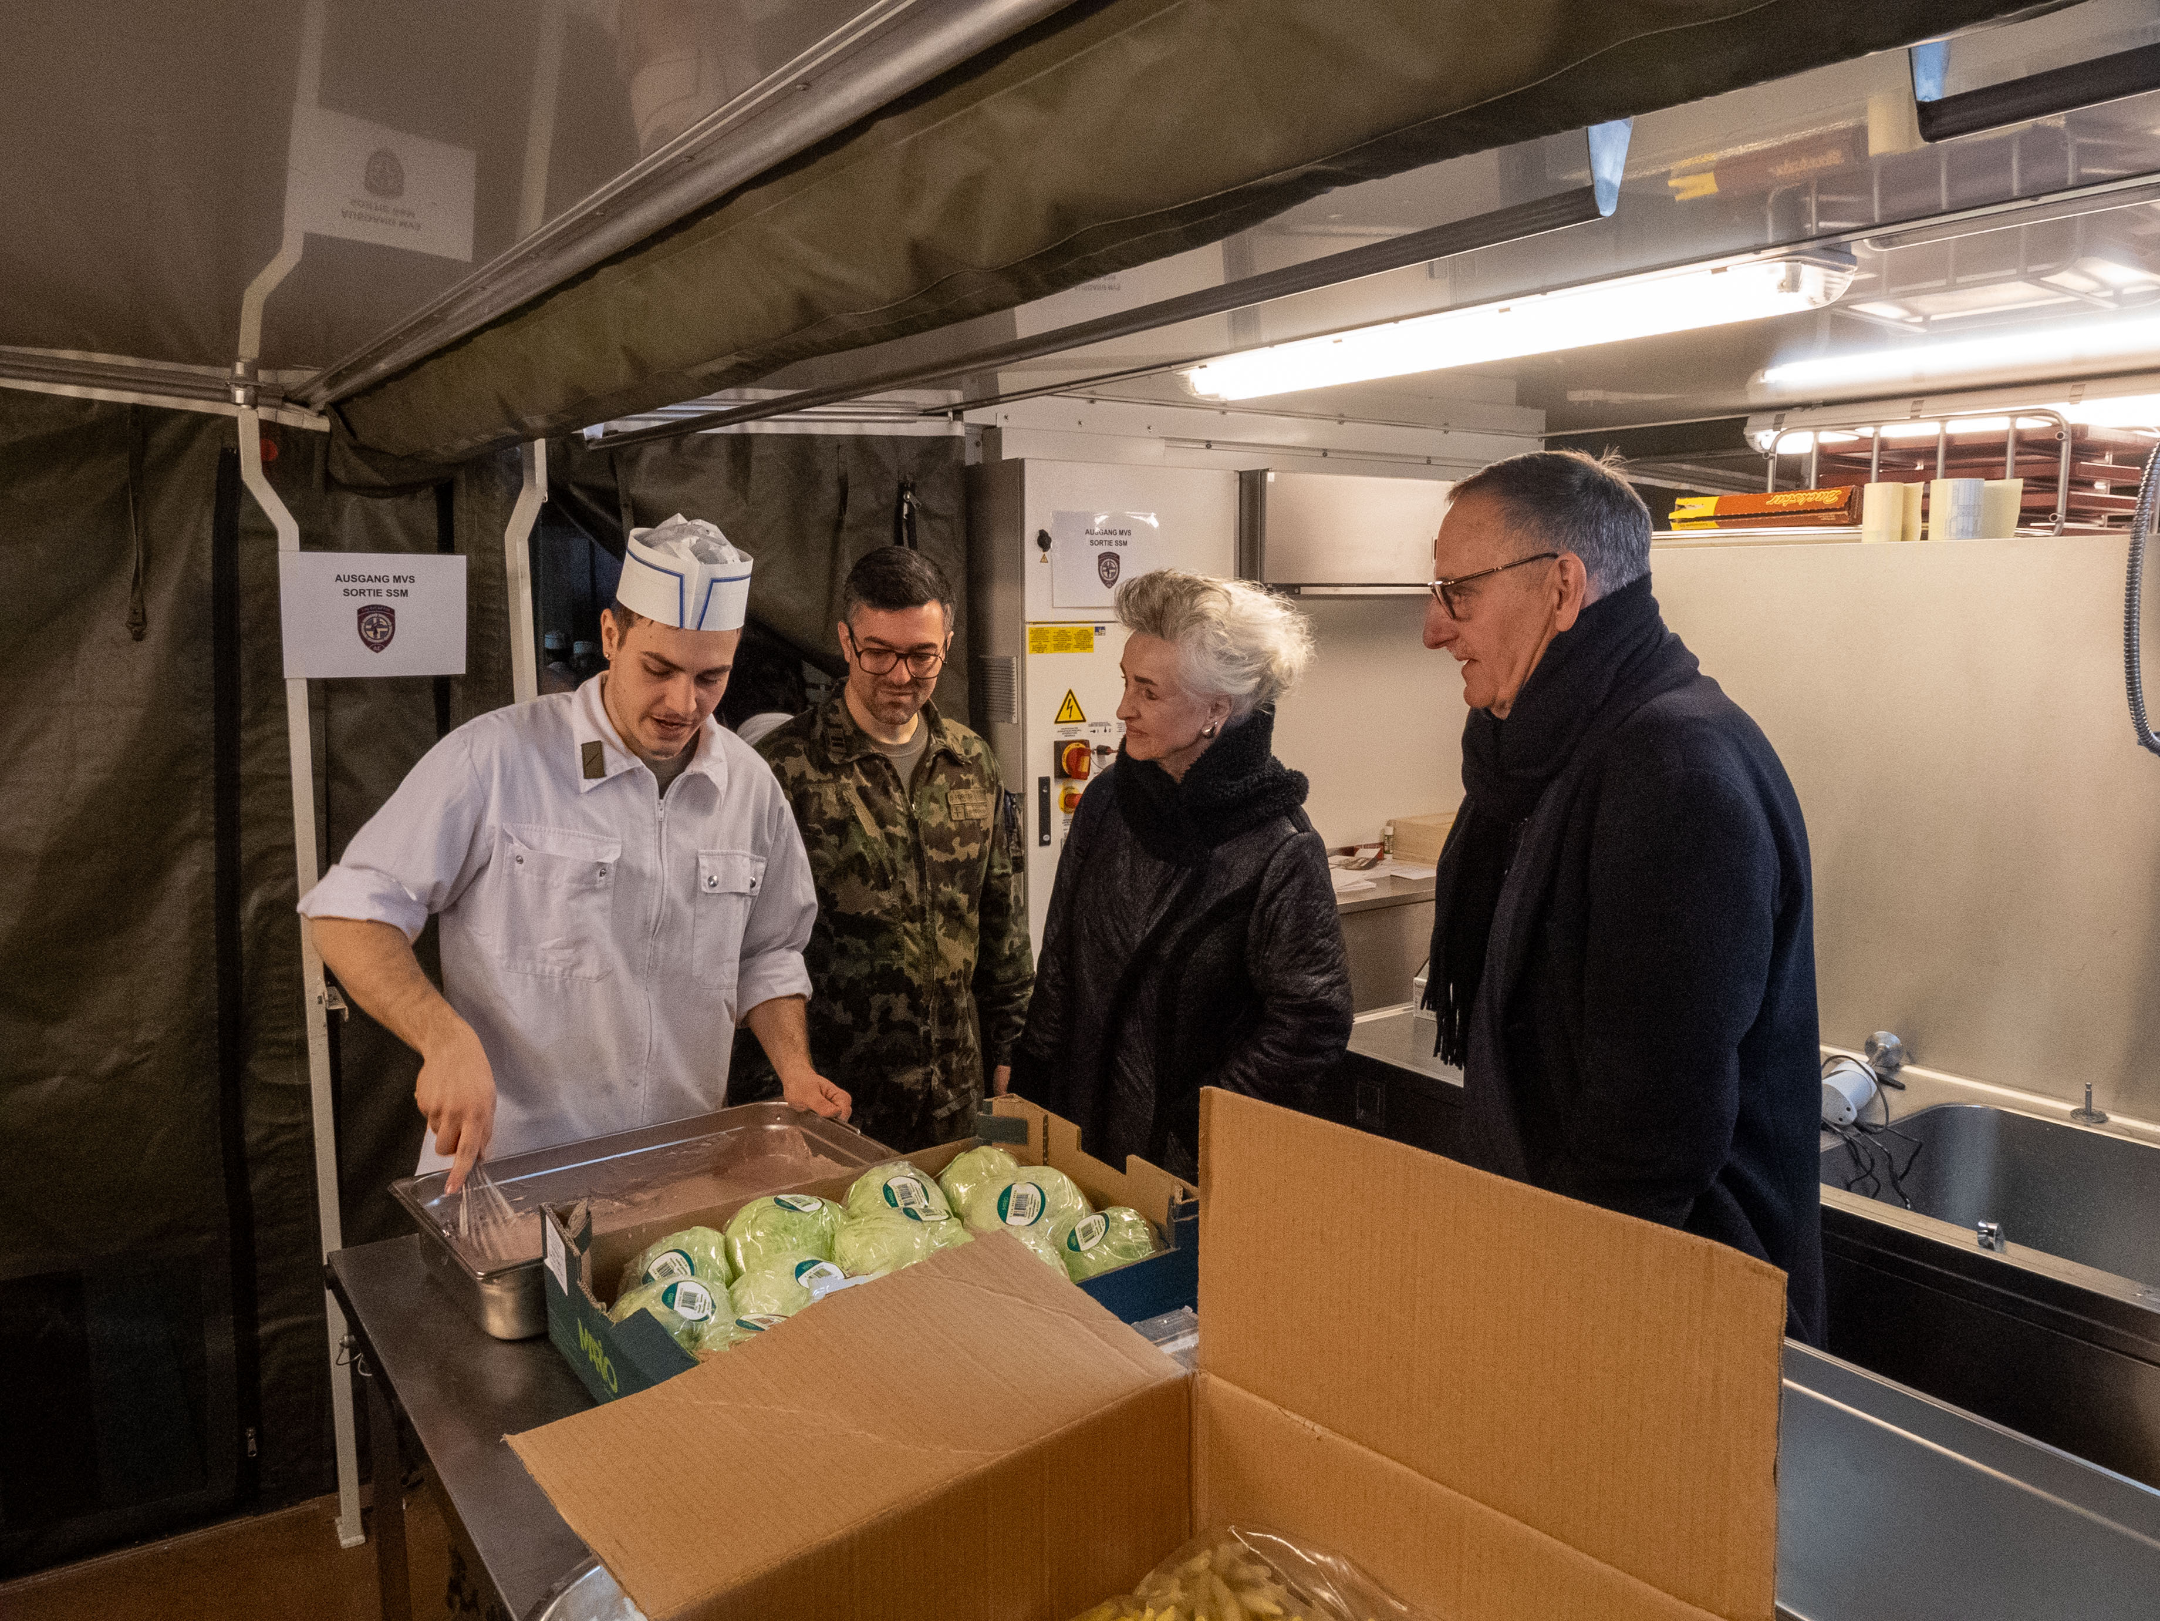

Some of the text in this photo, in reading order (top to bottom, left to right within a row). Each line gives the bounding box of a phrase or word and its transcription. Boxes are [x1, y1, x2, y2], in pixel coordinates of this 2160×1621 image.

[1089, 539, 1113, 547] SORTIE
[334, 574, 416, 584] AUSGANG MVS
[342, 588, 409, 598] SORTIE SSM
